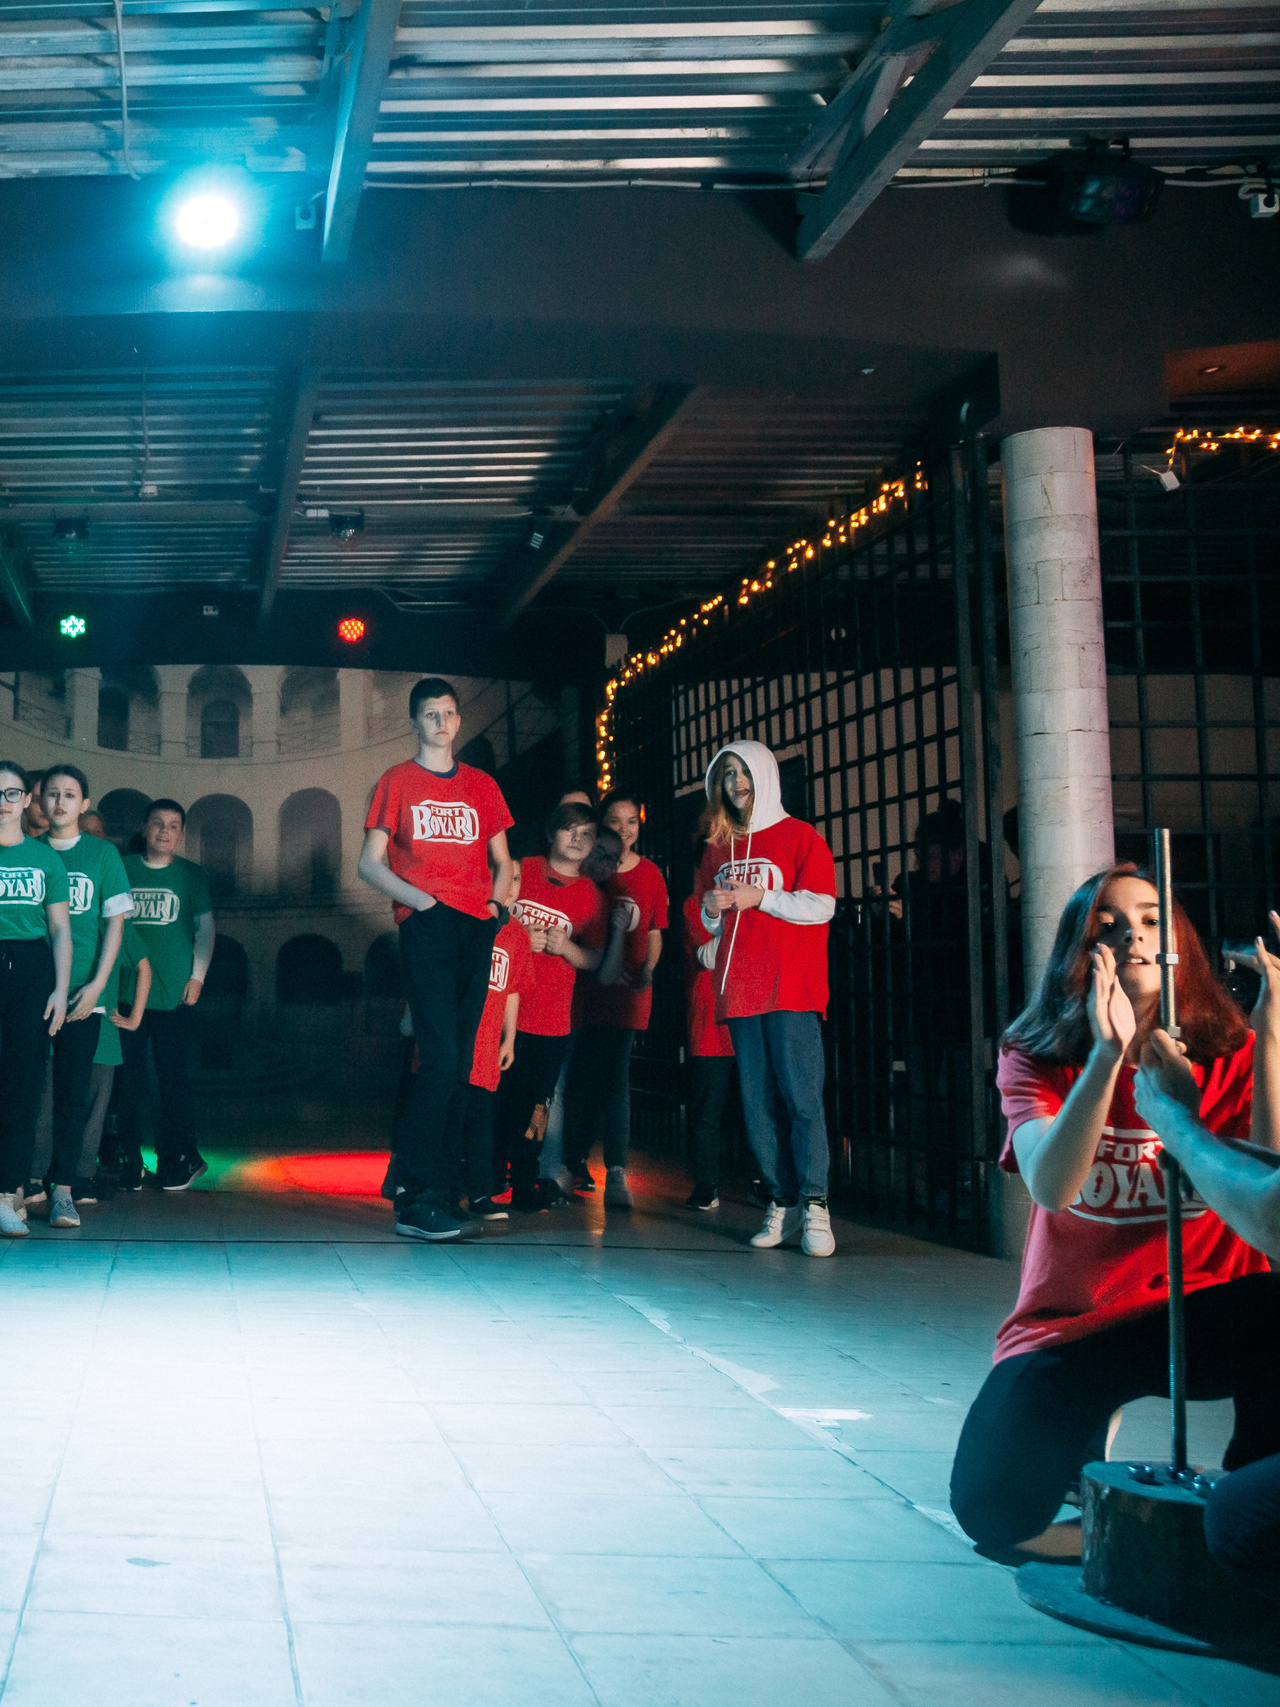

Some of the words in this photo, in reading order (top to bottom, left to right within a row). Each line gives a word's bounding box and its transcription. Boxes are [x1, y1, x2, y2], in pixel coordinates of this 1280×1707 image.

[430, 805, 462, 817] FORT
[410, 805, 480, 840] BOYARD
[133, 892, 164, 900] FORT
[132, 892, 180, 923] OYARD
[523, 905, 558, 923] FORT
